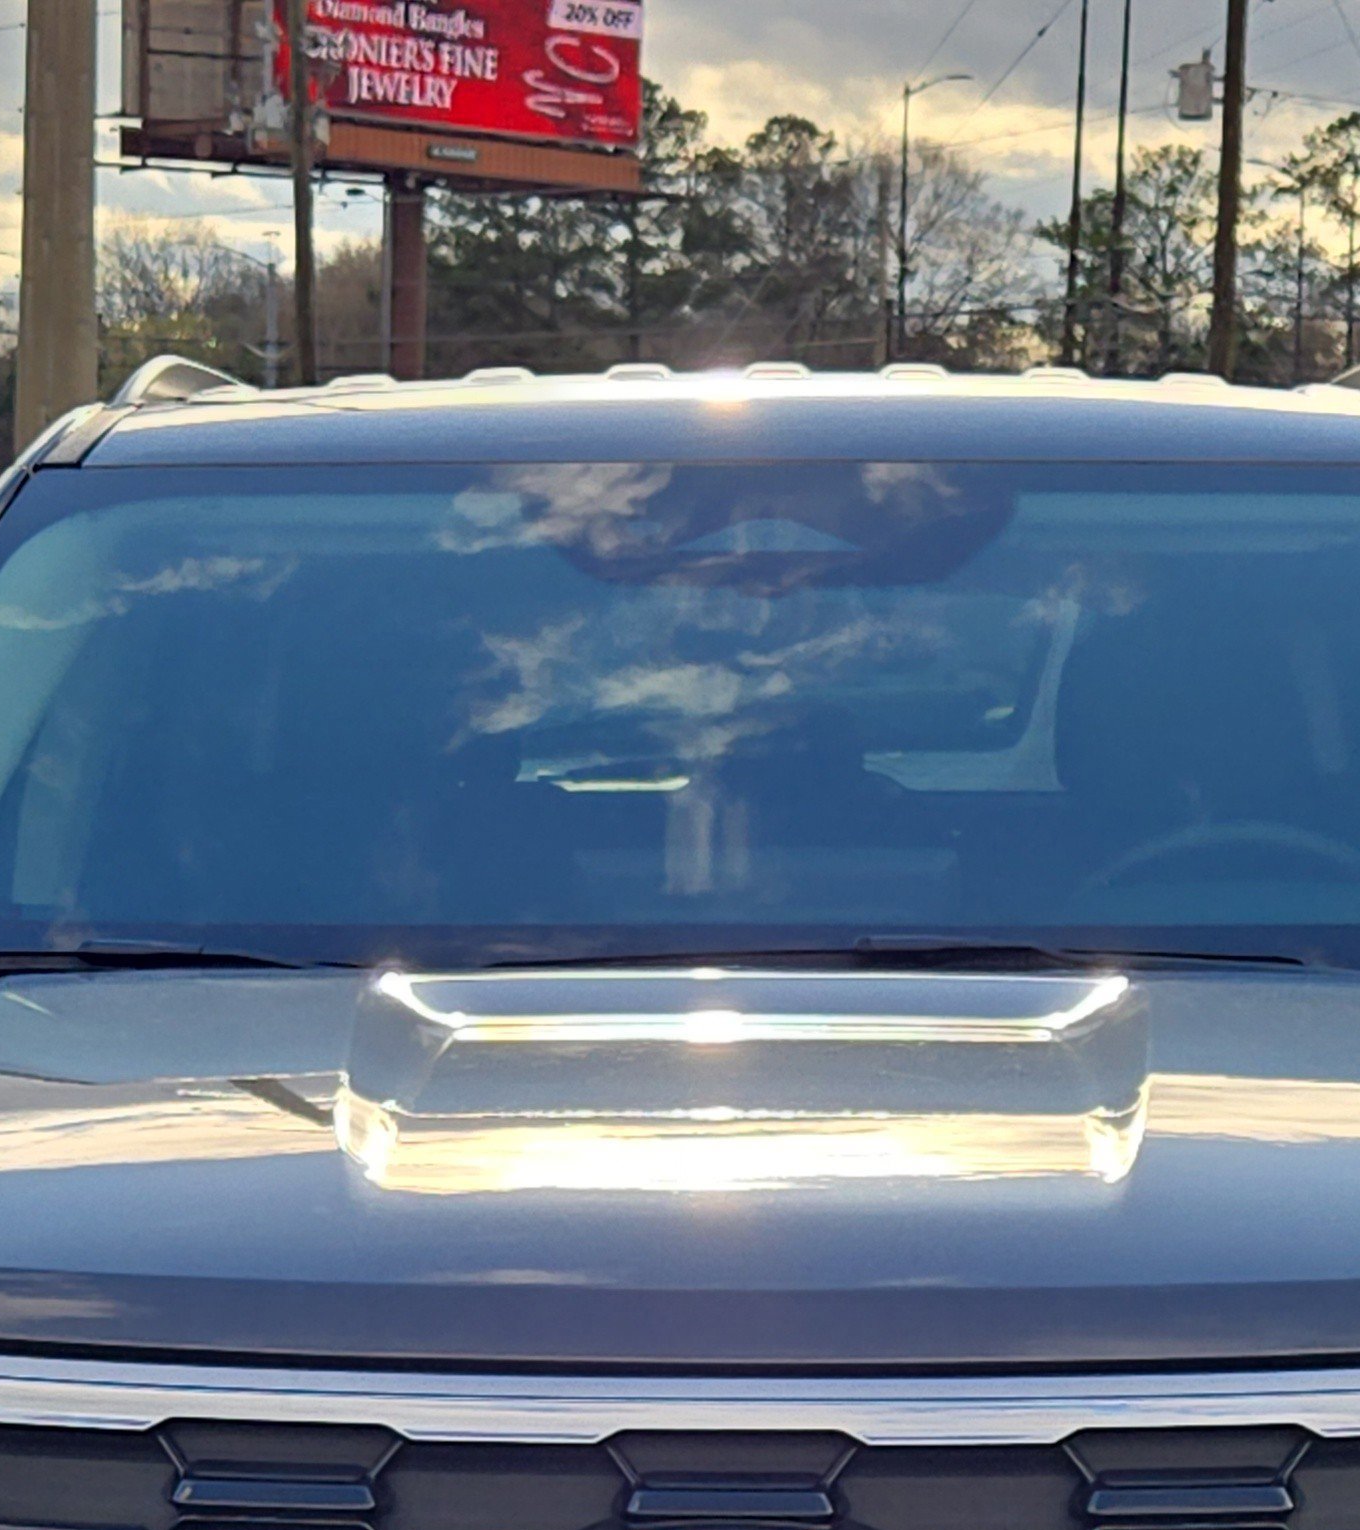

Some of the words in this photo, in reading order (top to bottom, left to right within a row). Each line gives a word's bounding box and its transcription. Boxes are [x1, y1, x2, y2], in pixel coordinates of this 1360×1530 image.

[565, 3, 598, 26] 20%
[602, 8, 634, 28] OFF
[439, 42, 499, 80] FINE
[348, 66, 457, 109] JEWELRY
